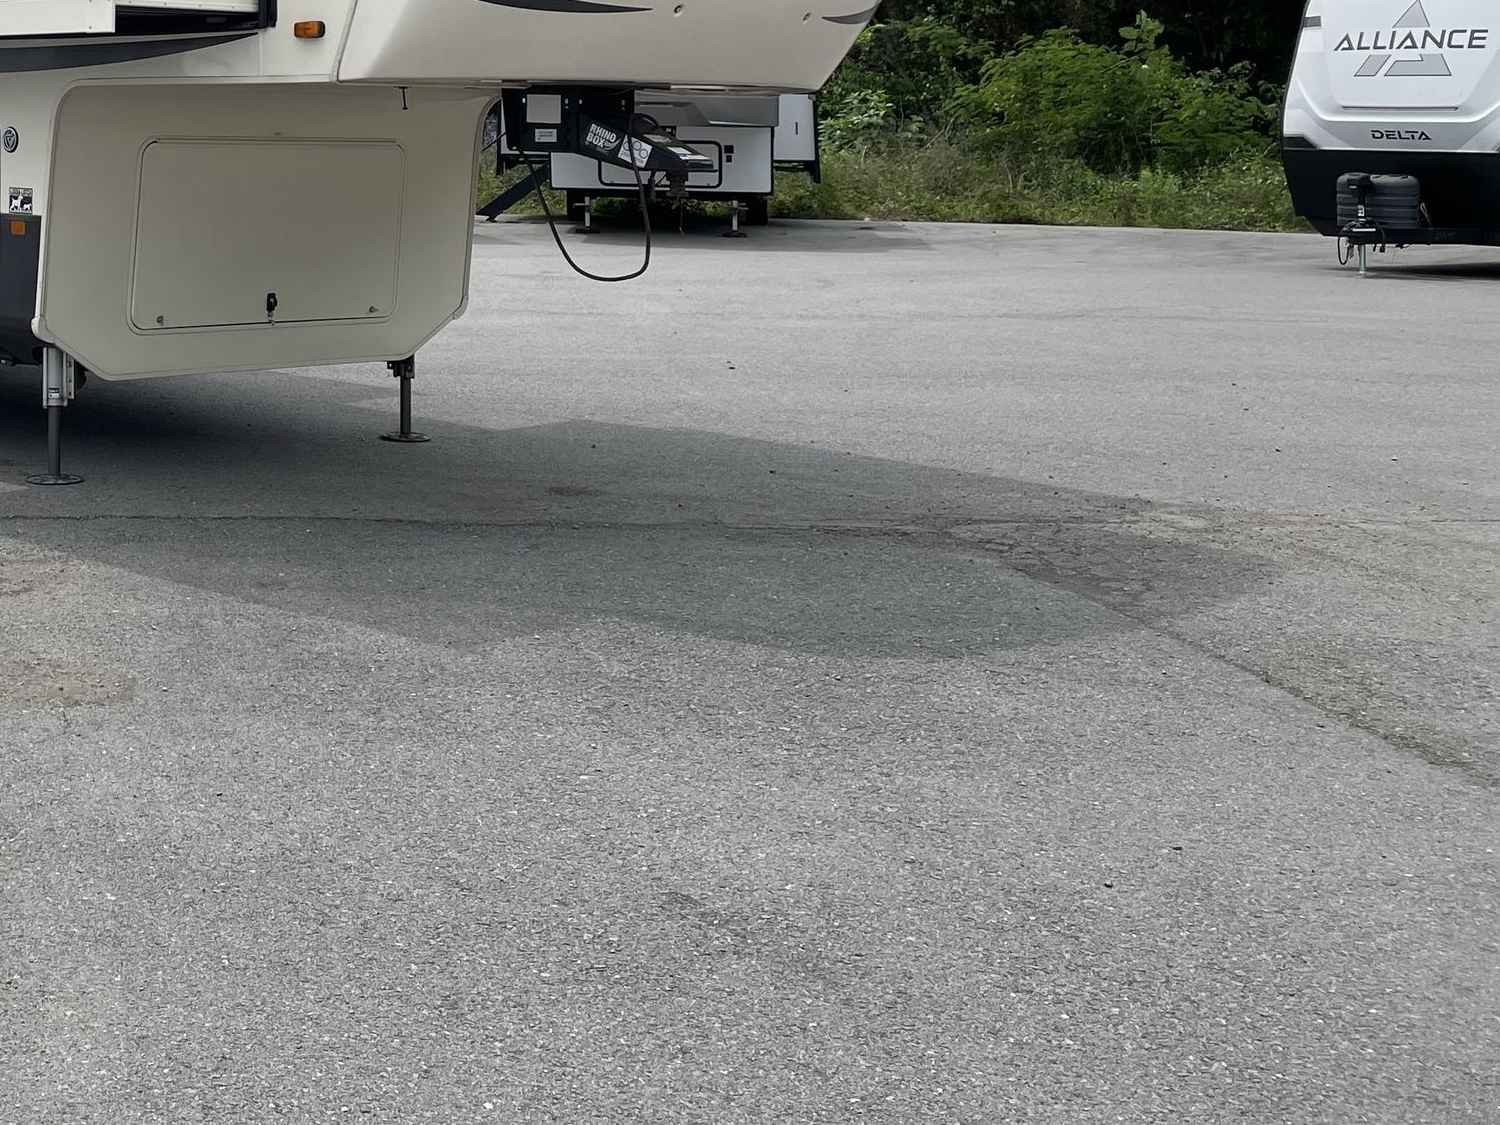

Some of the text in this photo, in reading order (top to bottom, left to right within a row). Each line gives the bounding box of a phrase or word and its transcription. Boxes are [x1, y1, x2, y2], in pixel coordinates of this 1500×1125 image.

[1332, 29, 1489, 52] ALLIANCE
[586, 132, 606, 148] BOX
[589, 123, 617, 143] RHINO
[1370, 129, 1432, 141] DELTA
